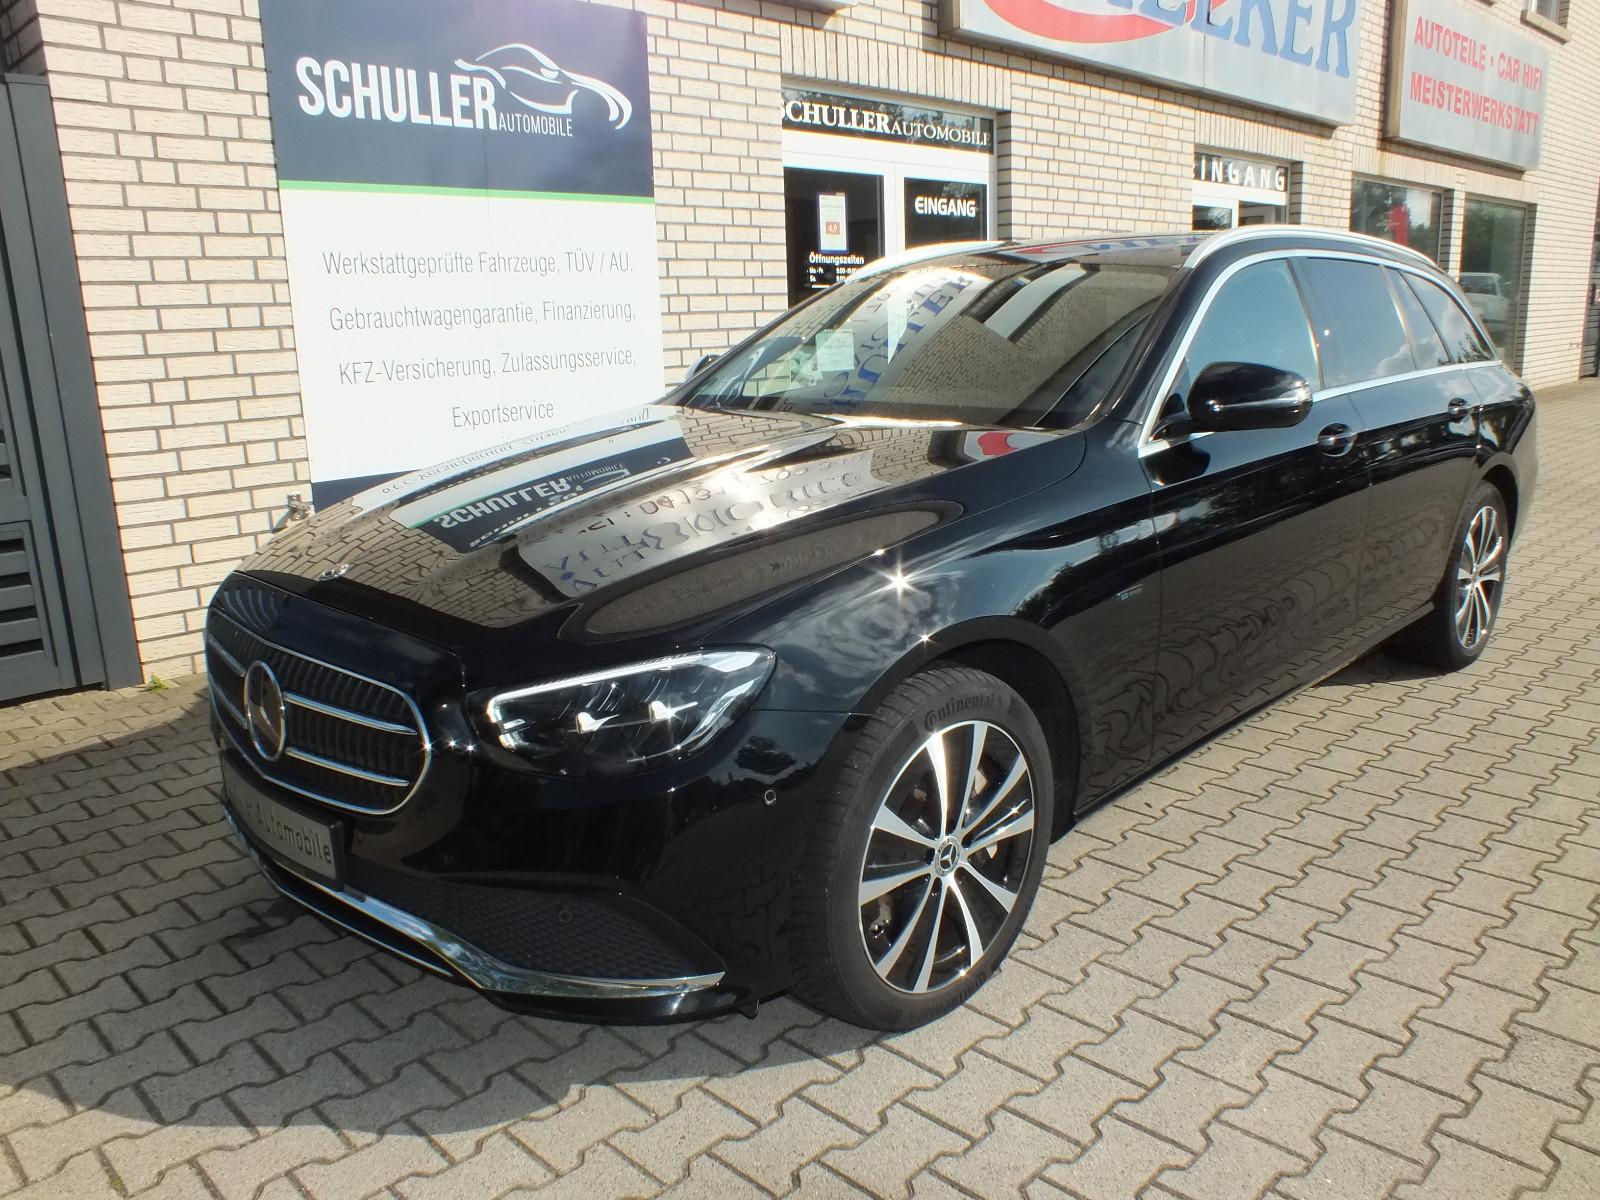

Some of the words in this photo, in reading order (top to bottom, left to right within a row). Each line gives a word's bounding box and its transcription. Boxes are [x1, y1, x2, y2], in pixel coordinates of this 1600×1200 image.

[1414, 16, 1487, 71] AUTOTEILE
[1498, 52, 1520, 85] CAR
[296, 57, 498, 131] SCHULLER
[499, 113, 573, 138] AUTOMOBILE
[1410, 72, 1539, 136] MEISTERWERKSTATT
[891, 120, 991, 146] AUTOMOBILE
[1193, 155, 1285, 192] INGANG
[914, 196, 976, 217] EINGANG
[322, 251, 474, 278] Werkstattgeprüfte
[478, 251, 560, 277] Fahrzeuge,
[564, 248, 594, 273] TÜV
[809, 251, 864, 266] Öffnungszeiten
[329, 302, 538, 331] Gebrauchtwagengarantie,
[543, 300, 636, 323] Finanzierung,
[339, 357, 496, 385] KFZ-Versicherung,
[501, 346, 637, 373] Zulassungsservice,
[452, 399, 554, 430] Exportservice
